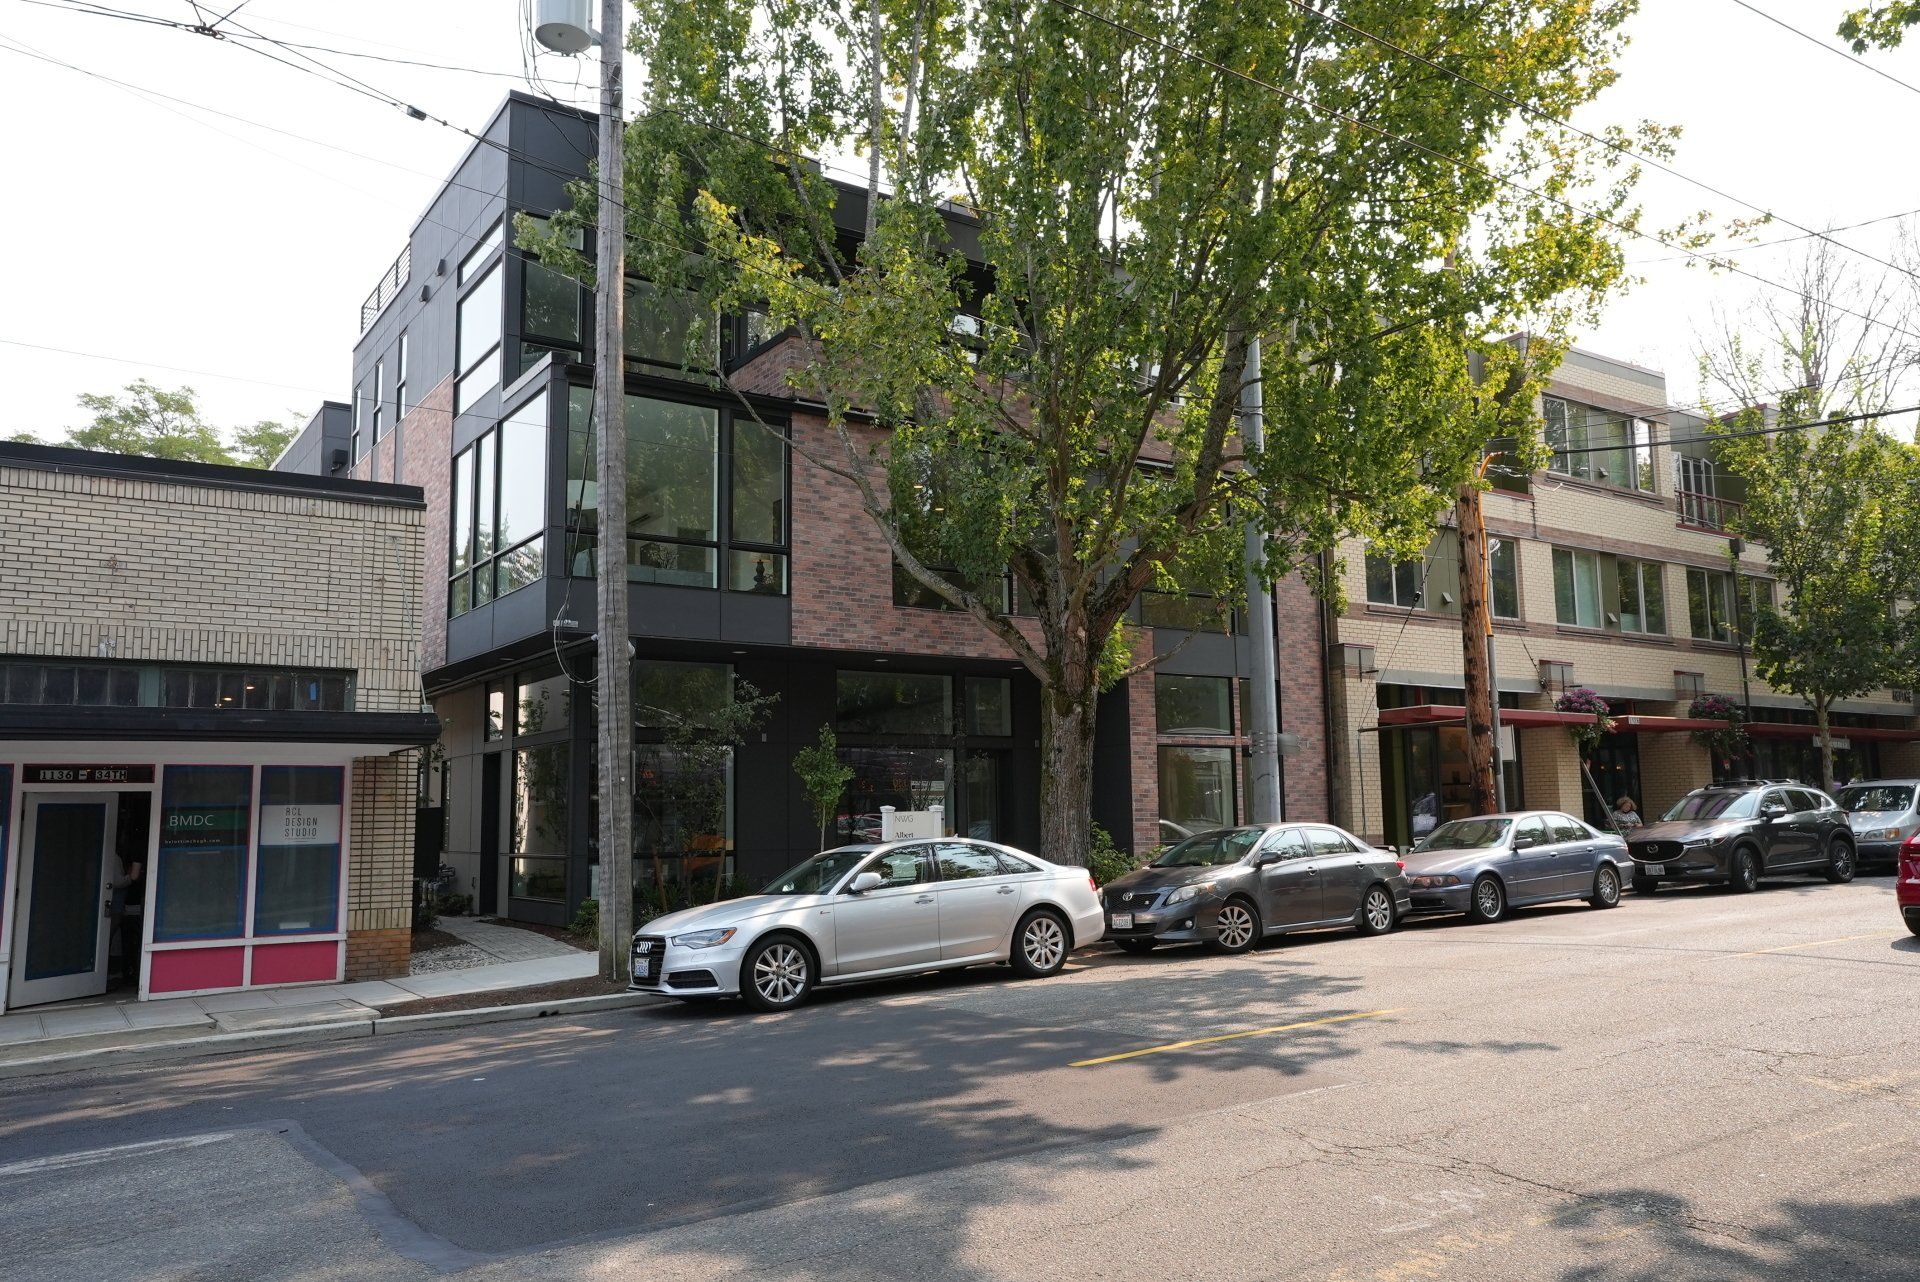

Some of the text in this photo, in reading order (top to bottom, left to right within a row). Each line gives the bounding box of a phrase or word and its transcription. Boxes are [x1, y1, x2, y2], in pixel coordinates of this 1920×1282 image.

[41, 770, 73, 779] 1136
[96, 770, 127, 779] 34TH
[285, 807, 303, 816] RCL
[169, 814, 215, 827] BMDC
[285, 817, 318, 827] DESIGN
[284, 827, 317, 837] STUDIO
[895, 831, 914, 839] Albert
